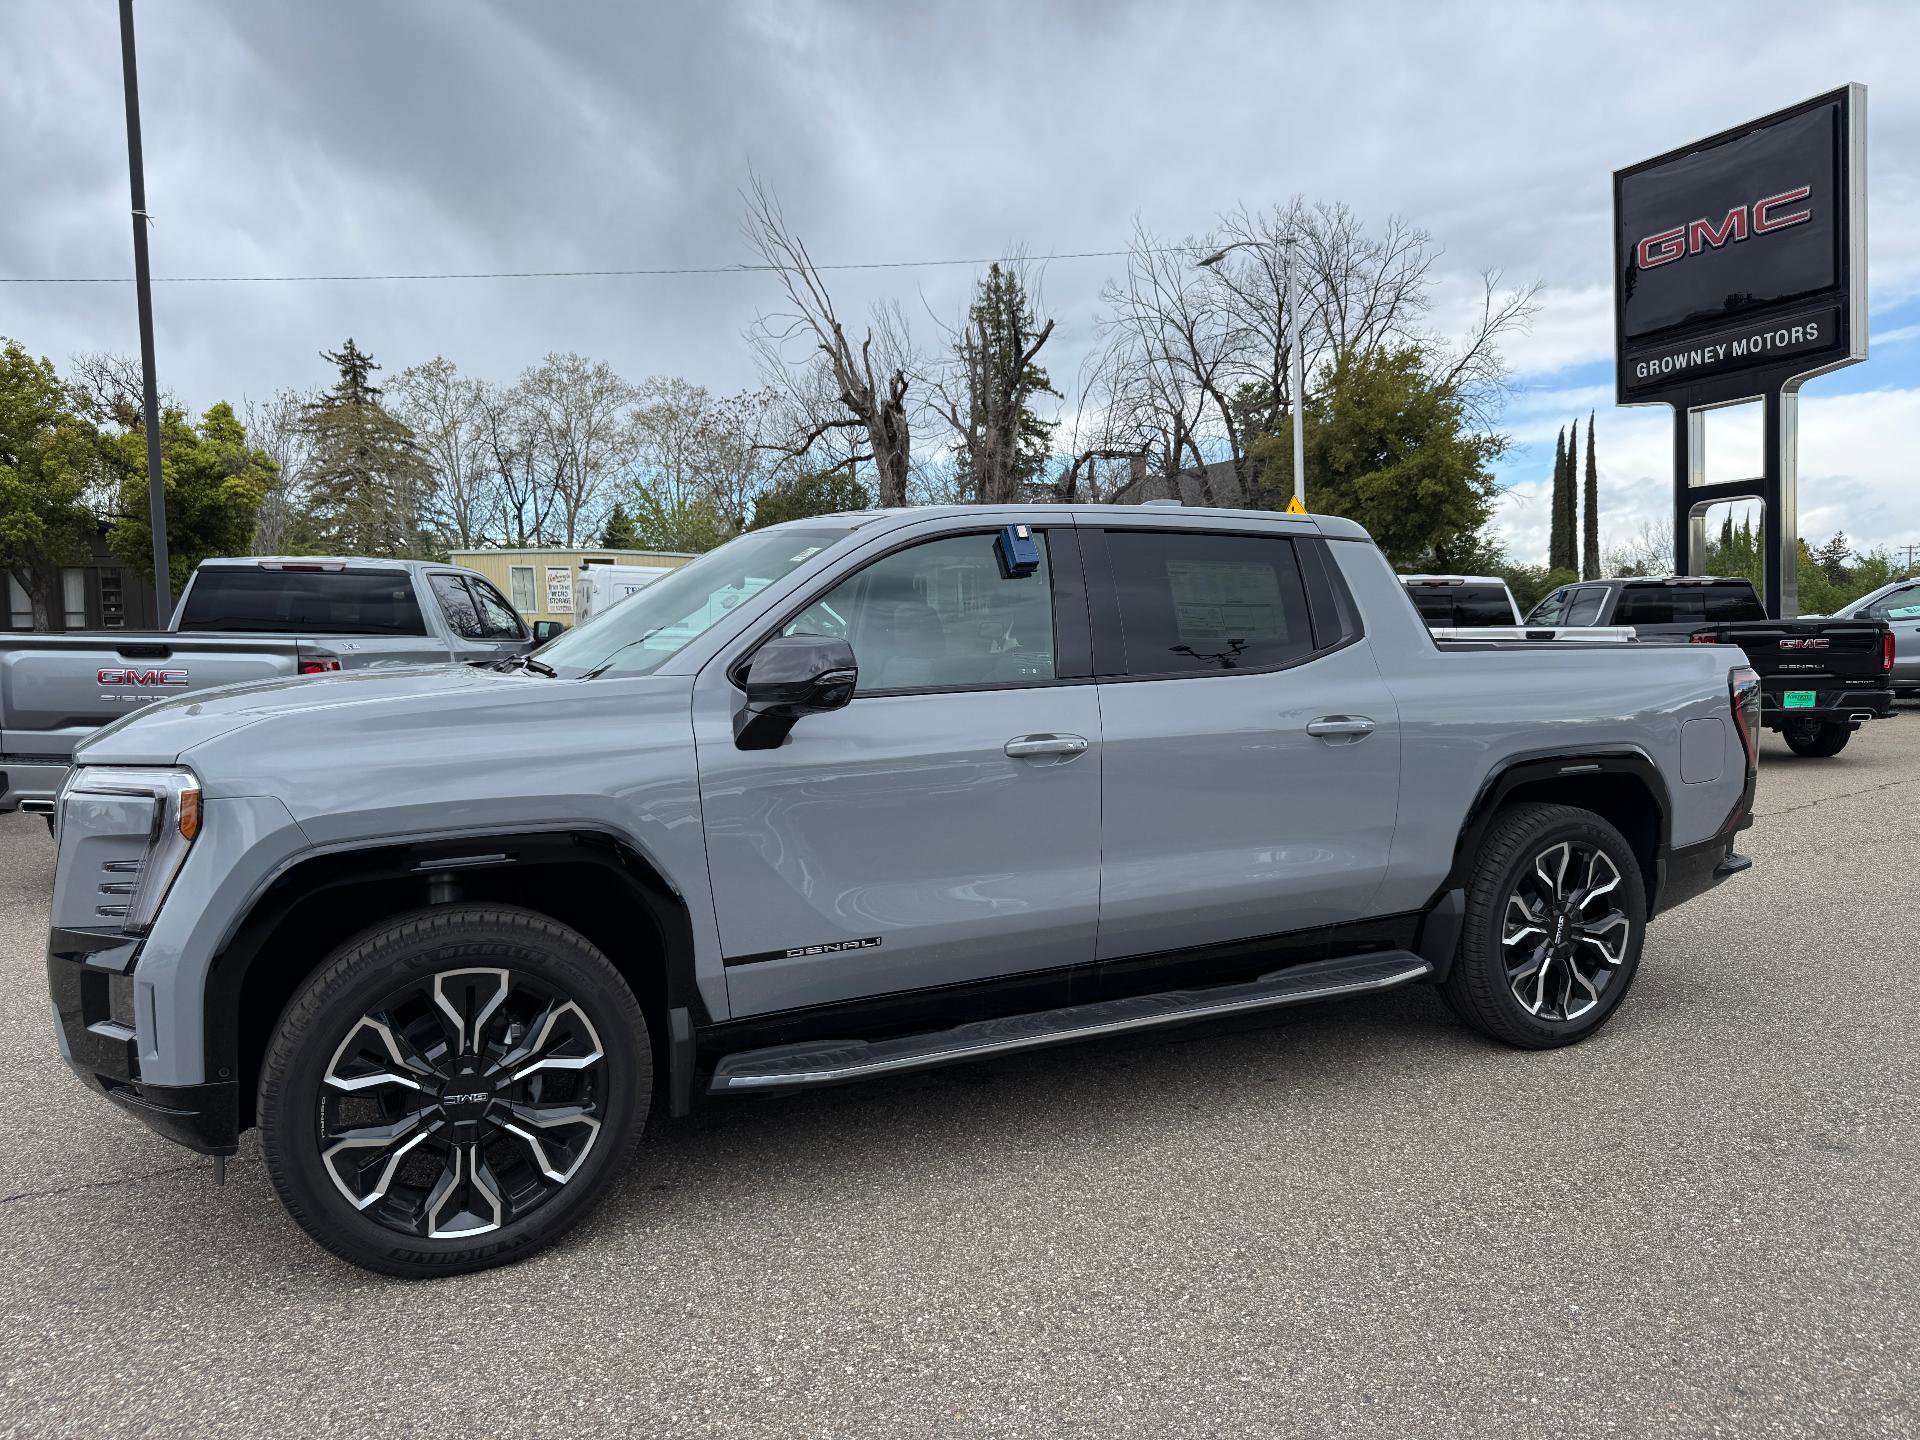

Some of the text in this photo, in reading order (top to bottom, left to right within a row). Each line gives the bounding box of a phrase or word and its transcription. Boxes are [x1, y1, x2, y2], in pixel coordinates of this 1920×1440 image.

[1636, 185, 1812, 270] GMC
[1636, 322, 1819, 377] GROWNEY MOTORS
[1779, 638, 1830, 649] GMC
[96, 668, 189, 688] GMC
[100, 694, 169, 702] SIERR
[787, 937, 881, 958] DENALI
[443, 1092, 489, 1107] GMC
